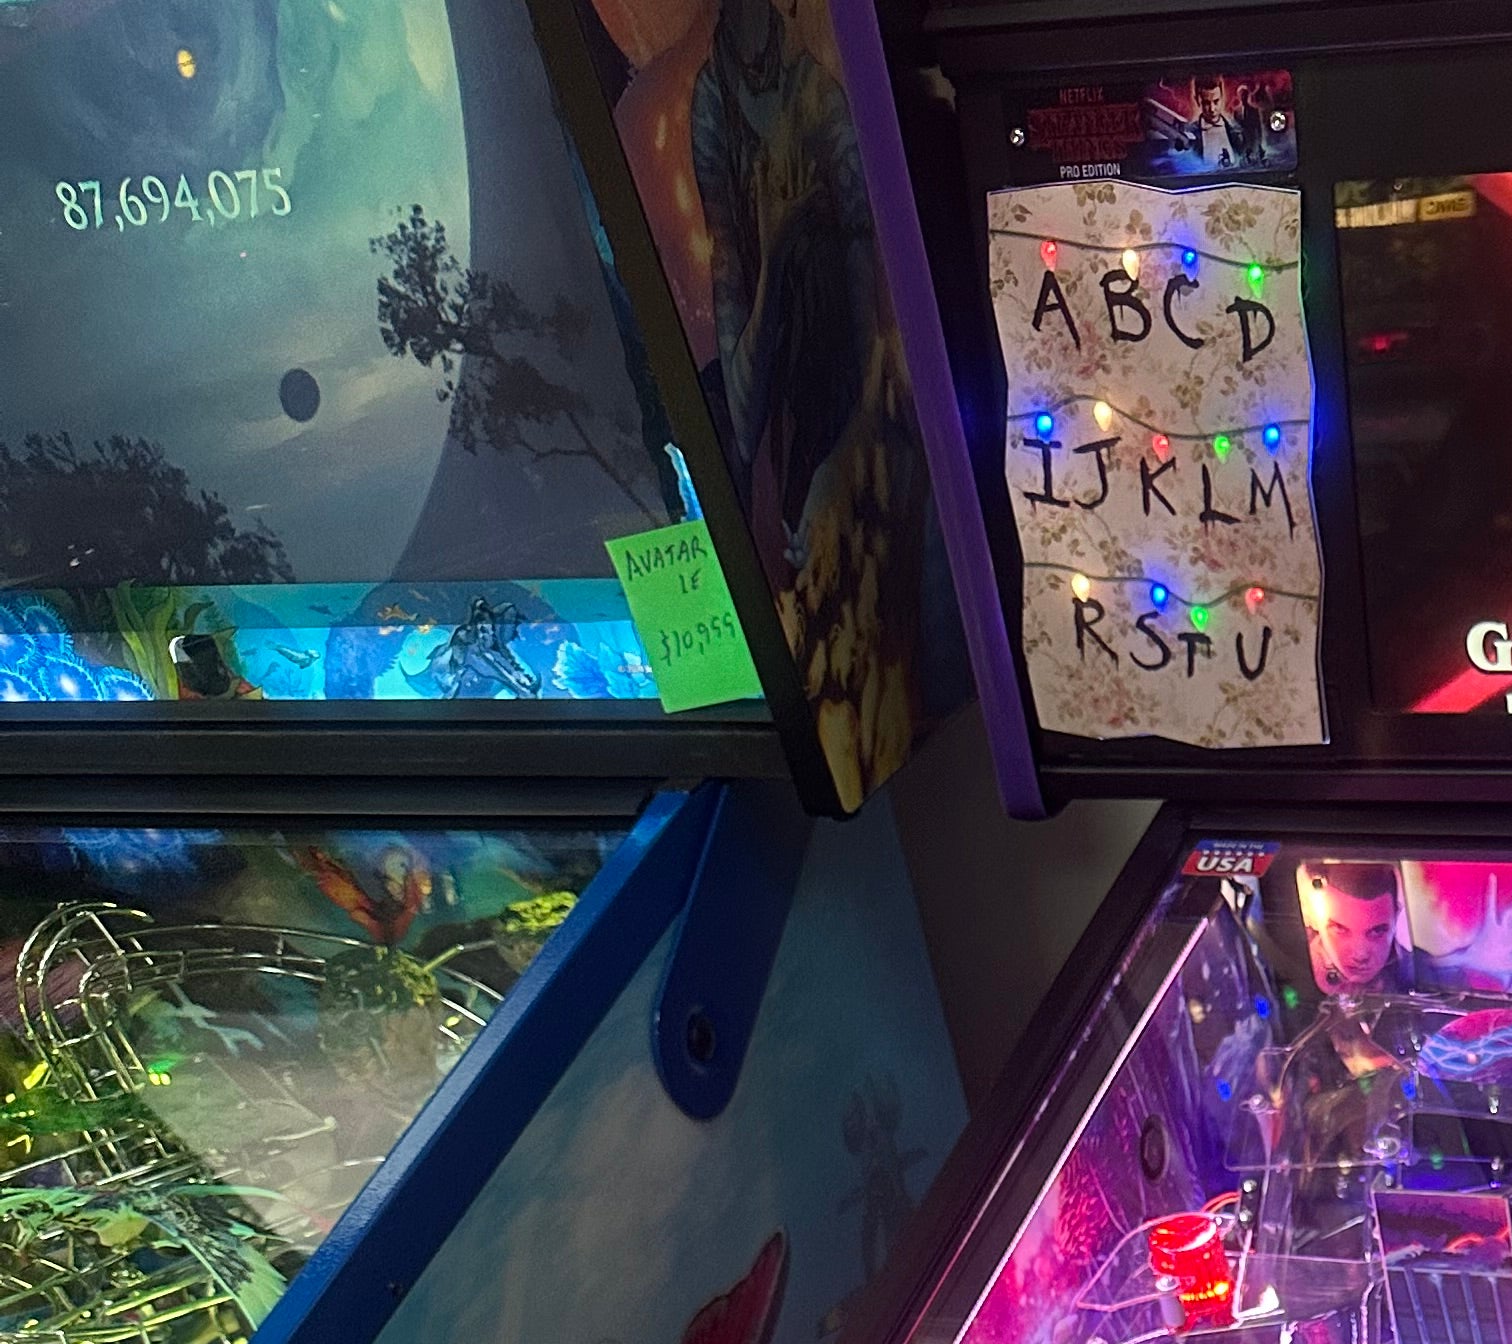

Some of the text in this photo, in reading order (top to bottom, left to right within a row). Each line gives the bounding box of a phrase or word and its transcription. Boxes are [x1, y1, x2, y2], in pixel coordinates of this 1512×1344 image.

[1059, 86, 1104, 103] NETFLIX
[1060, 162, 1121, 179] PRO EDITION
[55, 167, 291, 232] 87,694,075
[625, 535, 708, 581] AVATAR
[1197, 856, 1253, 872] USA
